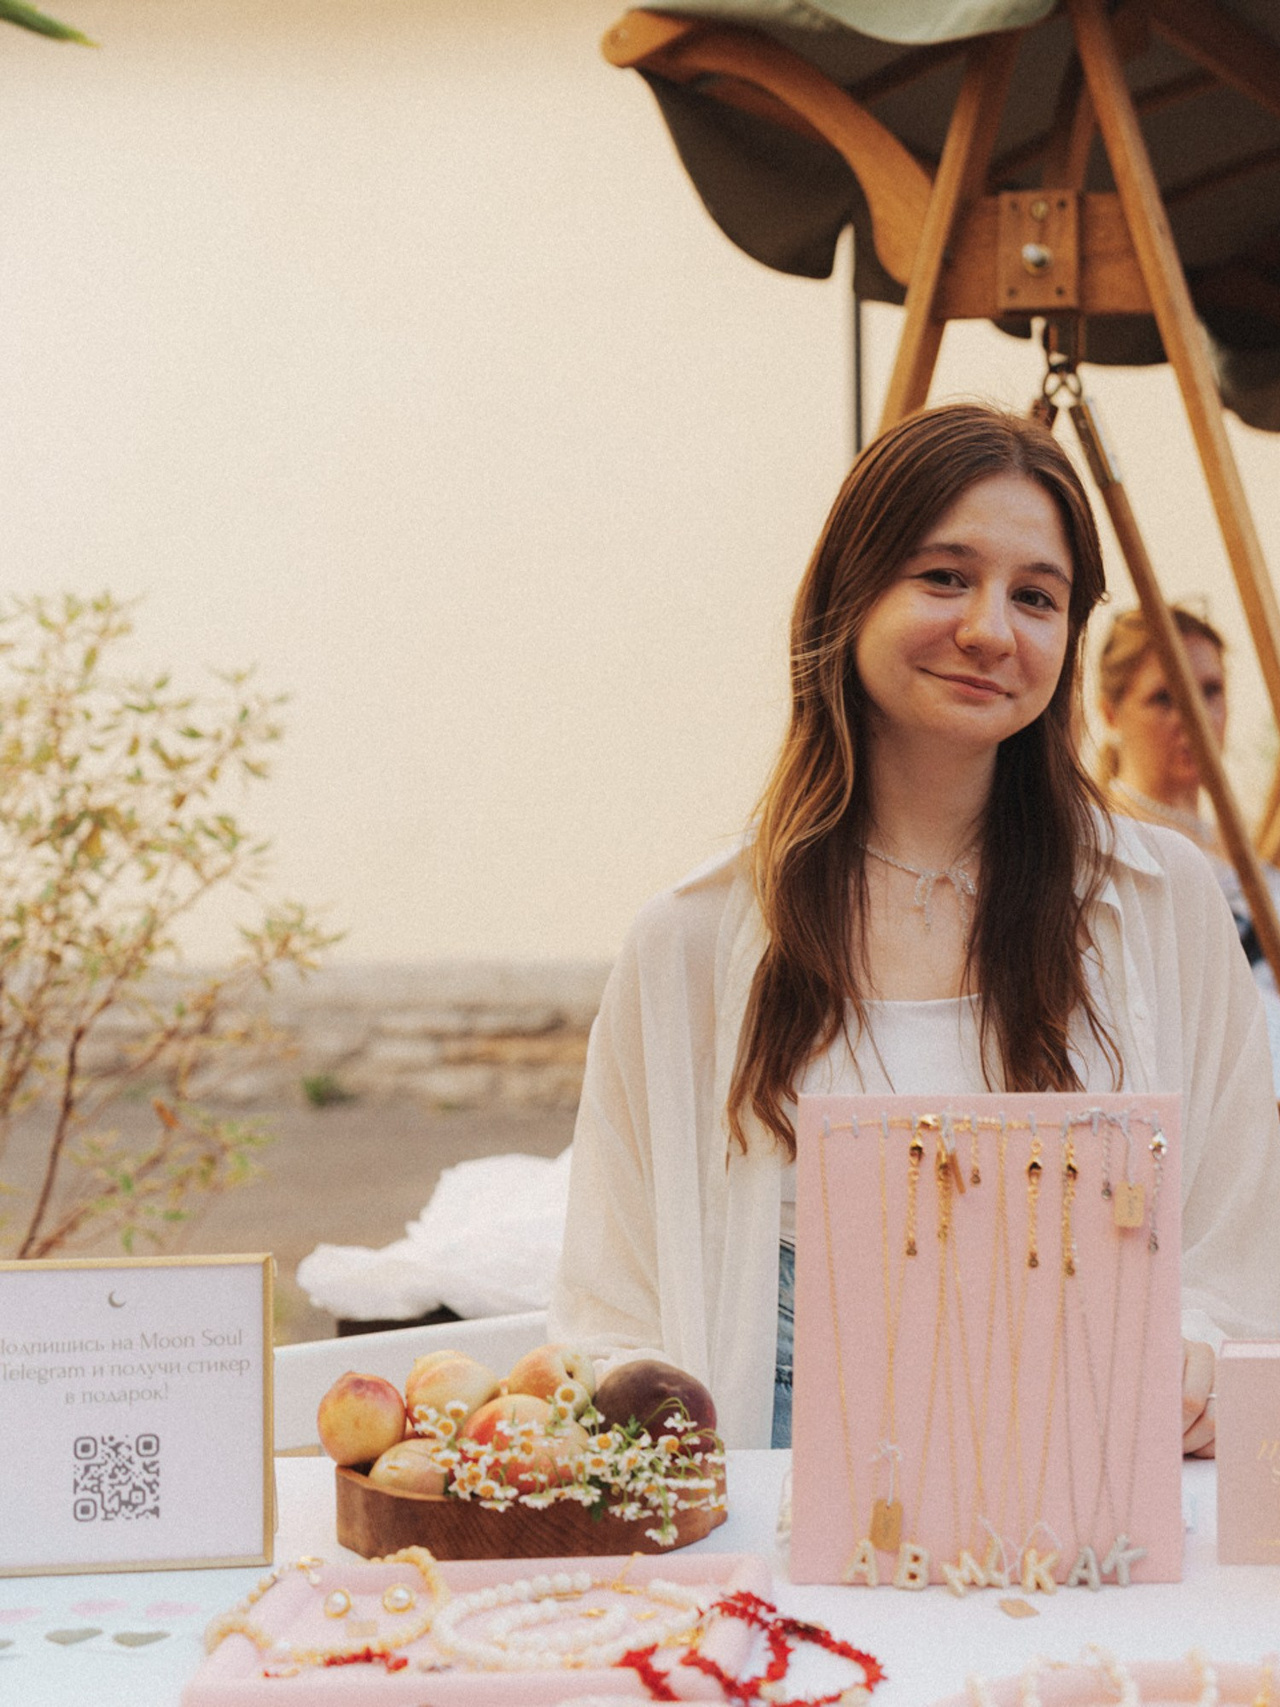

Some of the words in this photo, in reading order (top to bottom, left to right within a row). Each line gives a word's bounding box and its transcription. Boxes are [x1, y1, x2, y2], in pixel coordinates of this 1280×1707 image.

[111, 1337, 133, 1351] на
[140, 1332, 195, 1350] Moon
[201, 1328, 243, 1347] Soul
[0, 1361, 85, 1385] Telegram
[92, 1363, 104, 1377] и
[110, 1362, 181, 1379] получи
[187, 1357, 250, 1376] стикер
[64, 1391, 75, 1404] в
[81, 1382, 169, 1406] подарок!
